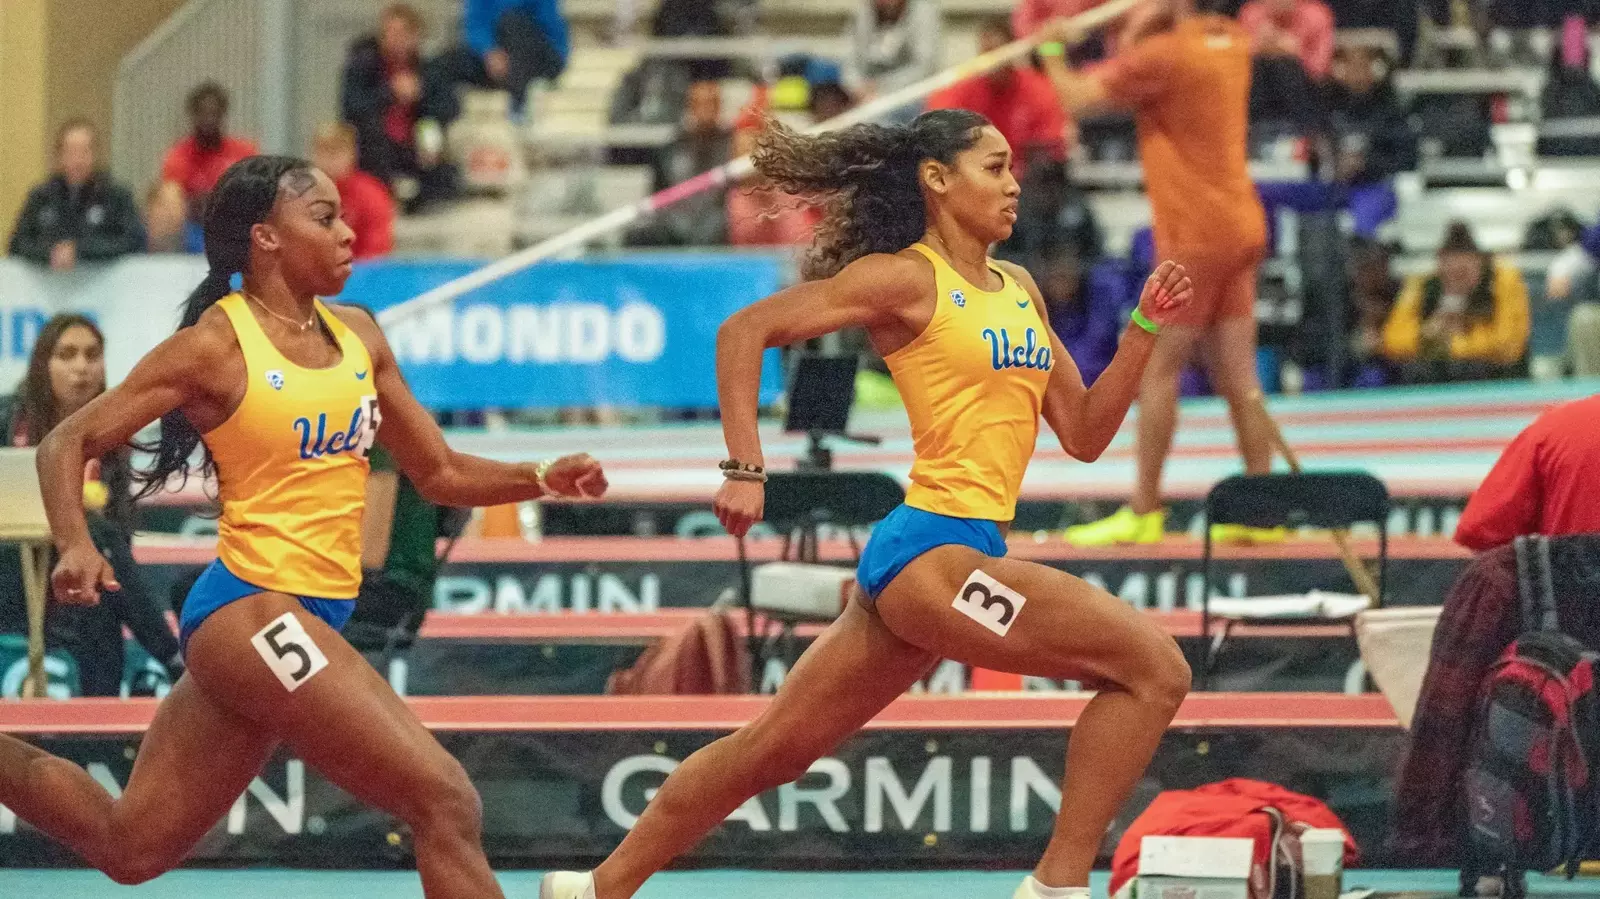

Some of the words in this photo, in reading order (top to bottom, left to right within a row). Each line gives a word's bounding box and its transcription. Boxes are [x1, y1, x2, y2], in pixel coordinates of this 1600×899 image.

[391, 302, 664, 363] MONDO
[982, 328, 1051, 372] Ucla
[293, 407, 362, 460] Ucl
[962, 581, 1014, 626] 3
[263, 621, 312, 682] 5
